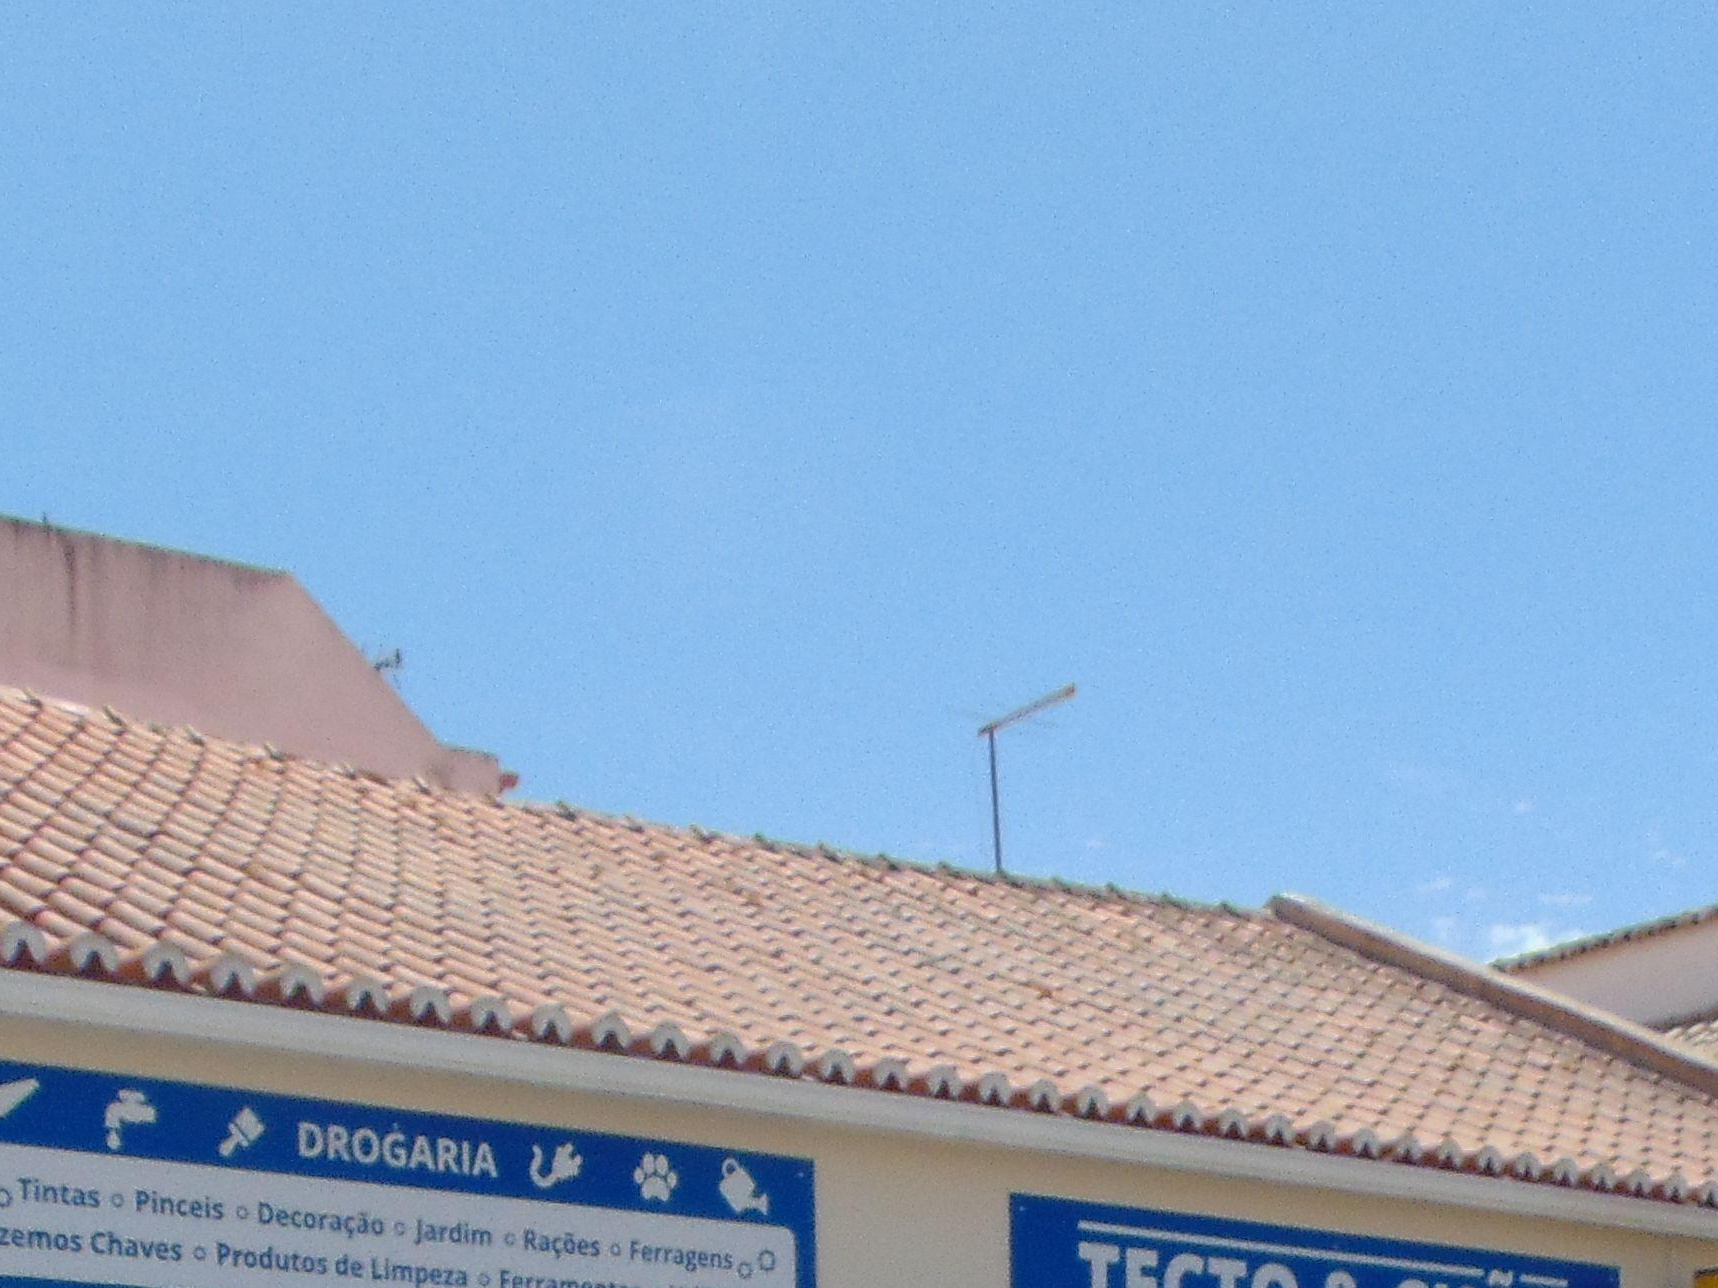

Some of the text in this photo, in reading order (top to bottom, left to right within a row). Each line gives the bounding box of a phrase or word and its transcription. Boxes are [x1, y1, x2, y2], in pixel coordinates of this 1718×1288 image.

[297, 1121, 499, 1179] DROGARIA
[18, 1177, 733, 1275] Tintas Pinceis Decoração Jardim Rações Ferragens
[91, 1230, 183, 1262] Chaves
[216, 1242, 328, 1276] Produtos
[335, 1253, 363, 1278] de
